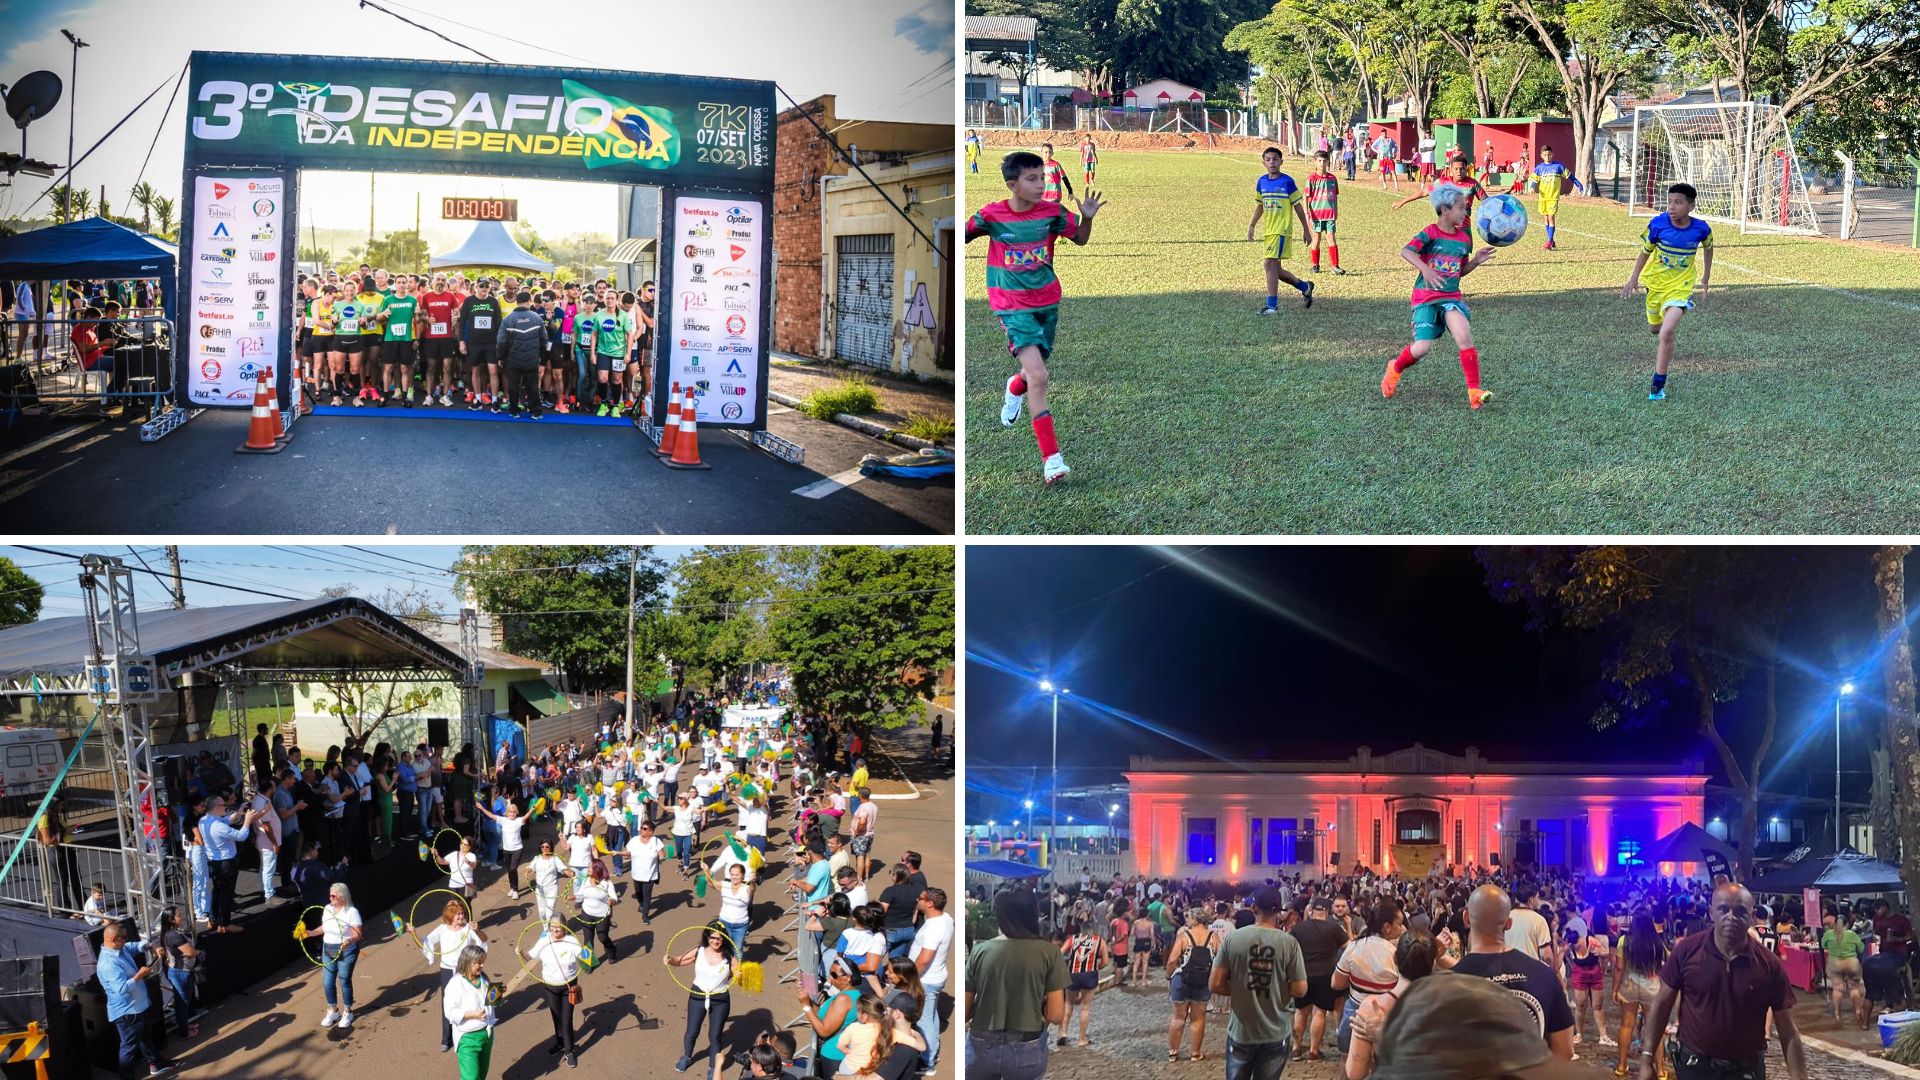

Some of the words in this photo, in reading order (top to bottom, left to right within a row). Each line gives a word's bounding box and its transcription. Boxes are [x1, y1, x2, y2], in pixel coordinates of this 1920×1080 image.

[311, 84, 613, 135] DESAFIO
[698, 102, 747, 131] 7K
[753, 107, 762, 142] ODESSA
[304, 123, 355, 145] DA
[367, 126, 670, 162] INDEPENDÊNCIA
[696, 129, 746, 147] 07/SET
[697, 147, 747, 169] 2023
[753, 143, 762, 167] NOVA
[683, 207, 719, 217] betfast.io
[726, 214, 753, 225] Optilar
[248, 278, 275, 286] STRONG
[198, 310, 234, 320] betfast.io
[478, 319, 488, 327] 90
[683, 324, 711, 332] STRONG
[240, 371, 259, 381] Optil
